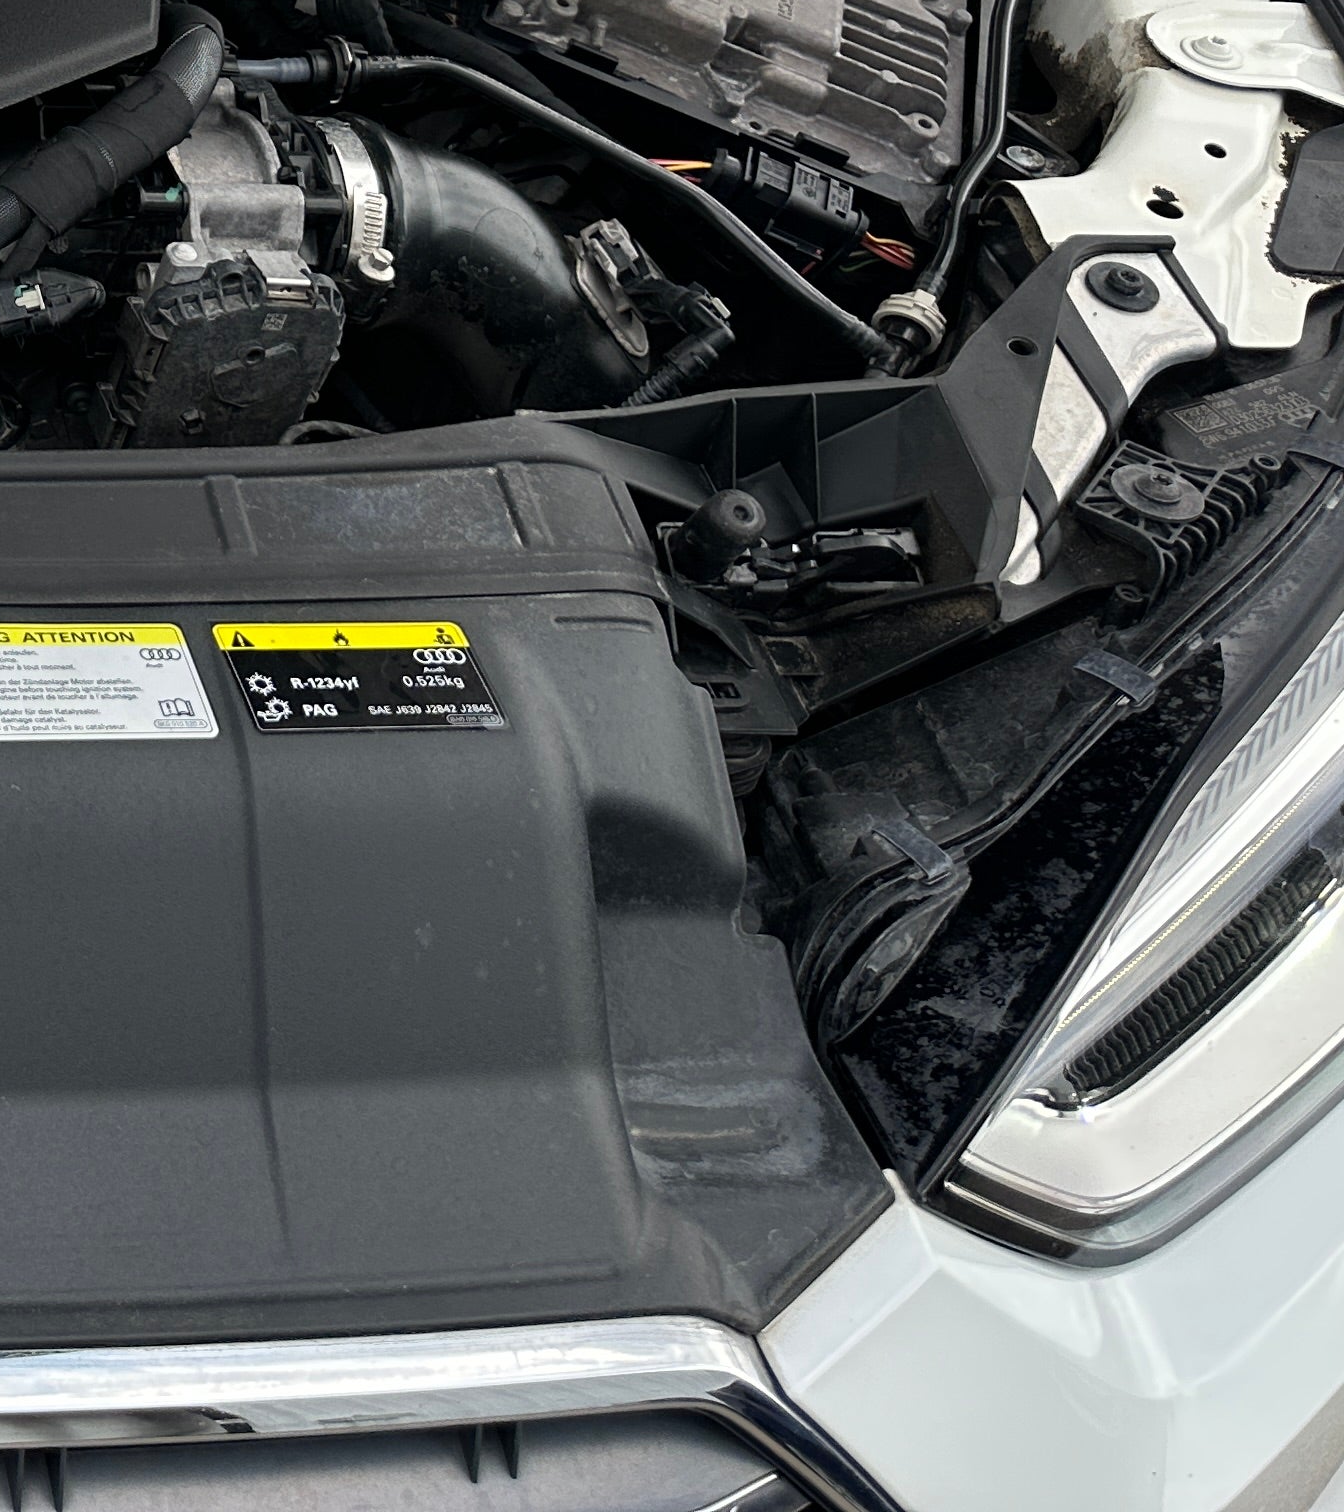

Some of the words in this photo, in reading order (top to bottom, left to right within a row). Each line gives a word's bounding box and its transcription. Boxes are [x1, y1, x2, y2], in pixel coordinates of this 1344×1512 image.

[22, 631, 135, 643] ATTENTION
[290, 677, 360, 692] R-1234yf
[302, 704, 339, 717] PAG
[368, 705, 392, 715] SAE
